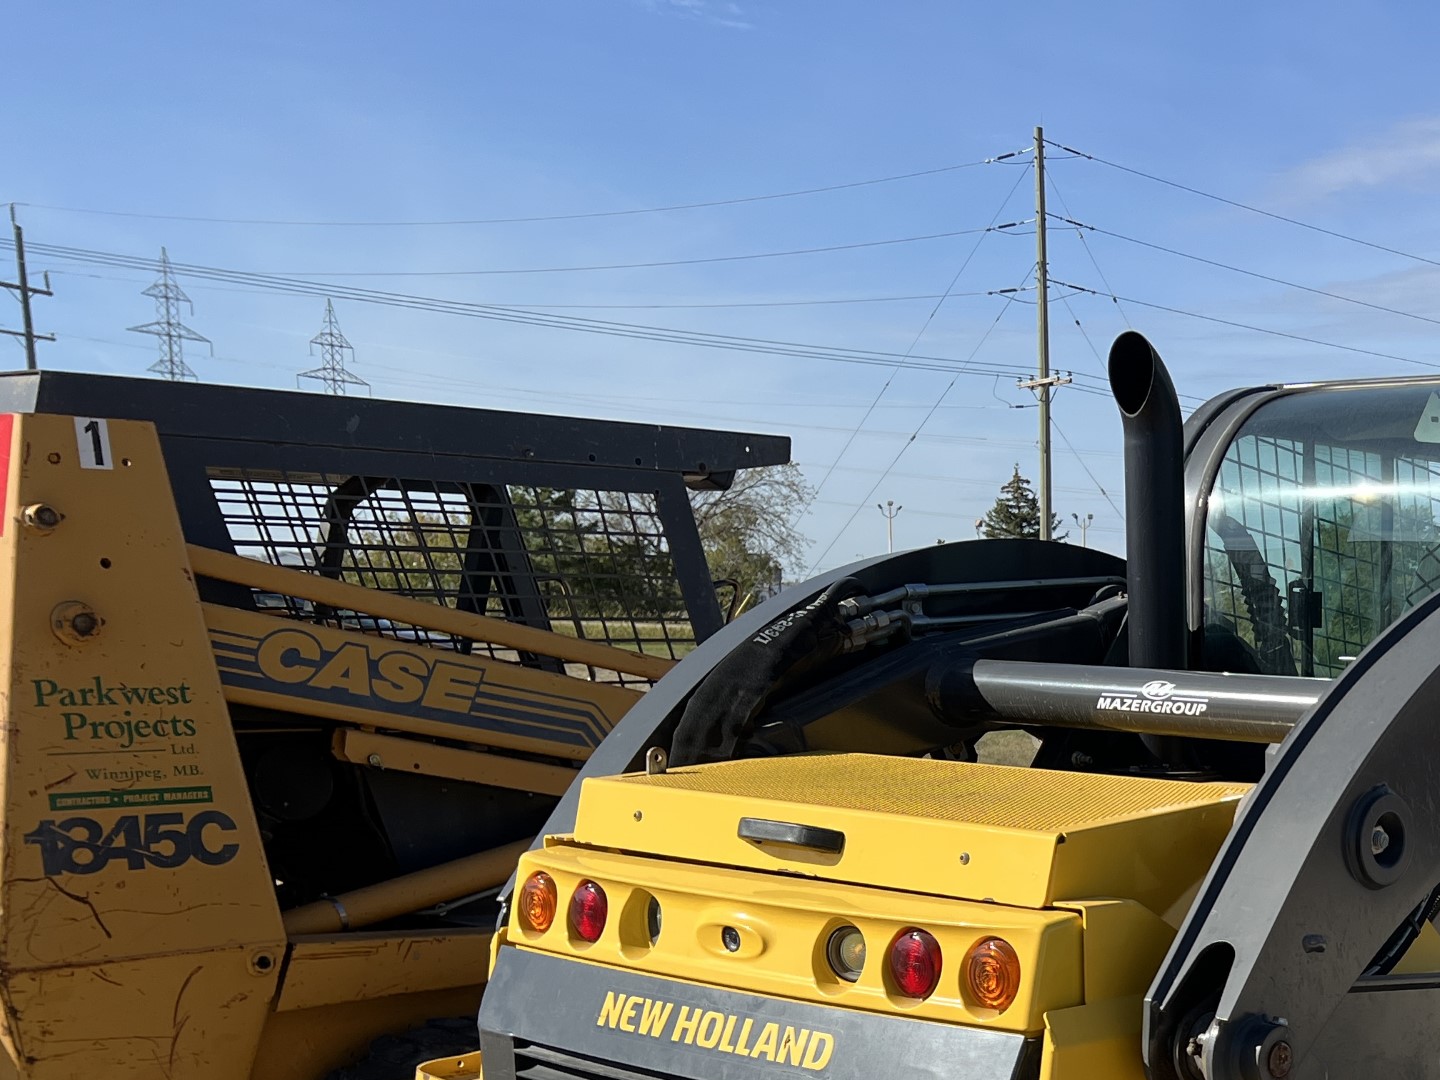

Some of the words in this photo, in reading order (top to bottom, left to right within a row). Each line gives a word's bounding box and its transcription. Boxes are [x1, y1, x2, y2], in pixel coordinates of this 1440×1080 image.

[84, 420, 105, 466] 1
[256, 627, 487, 715] CASE
[31, 676, 193, 708] Parkwest
[1097, 696, 1207, 716] MAZERGROUP
[62, 710, 197, 748] Projects
[171, 743, 200, 755] Ltd.
[85, 767, 168, 782] Winnipeg,
[173, 764, 204, 777] MB.
[123, 793, 160, 804] PROJECT
[163, 790, 209, 802] MANAGERS
[24, 810, 240, 876] 1845C
[597, 990, 674, 1037] NEW
[671, 1005, 835, 1071] HOLLAND
